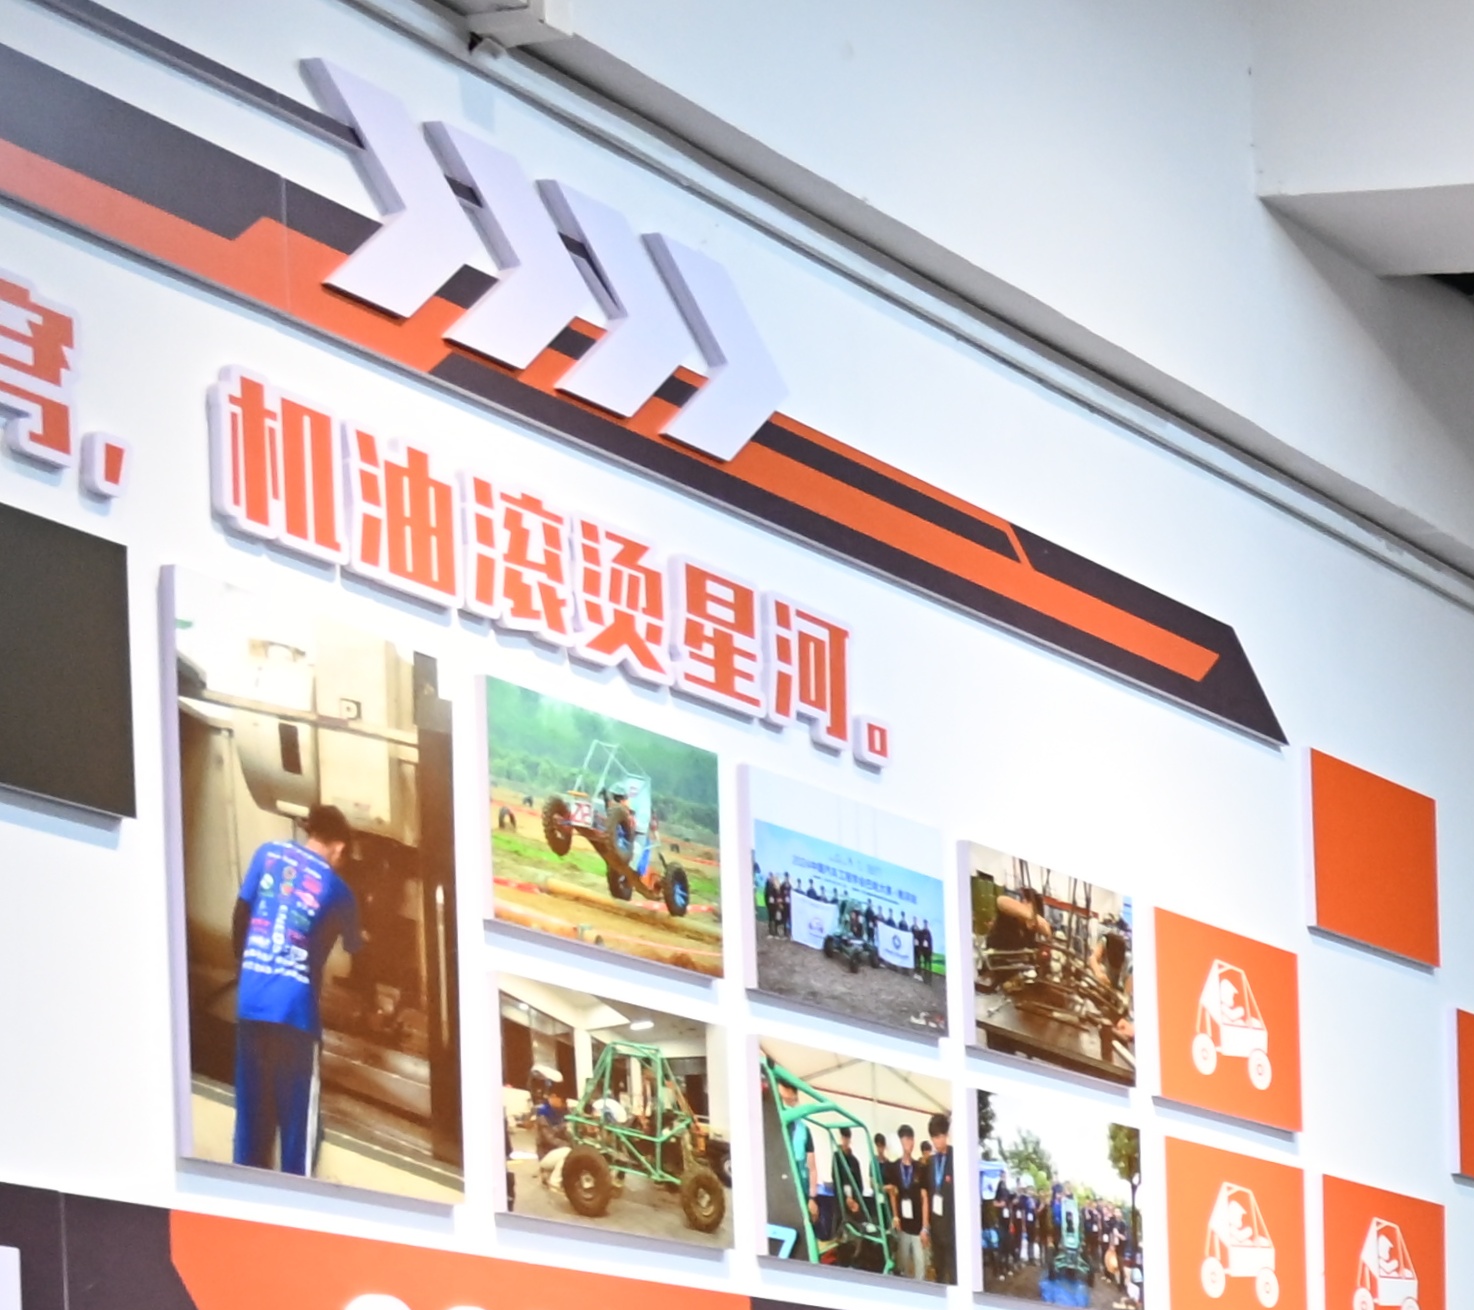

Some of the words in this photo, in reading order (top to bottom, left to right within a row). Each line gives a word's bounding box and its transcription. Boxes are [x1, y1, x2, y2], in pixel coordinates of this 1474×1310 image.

[229, 374, 888, 758] 机油滚烫星河。
